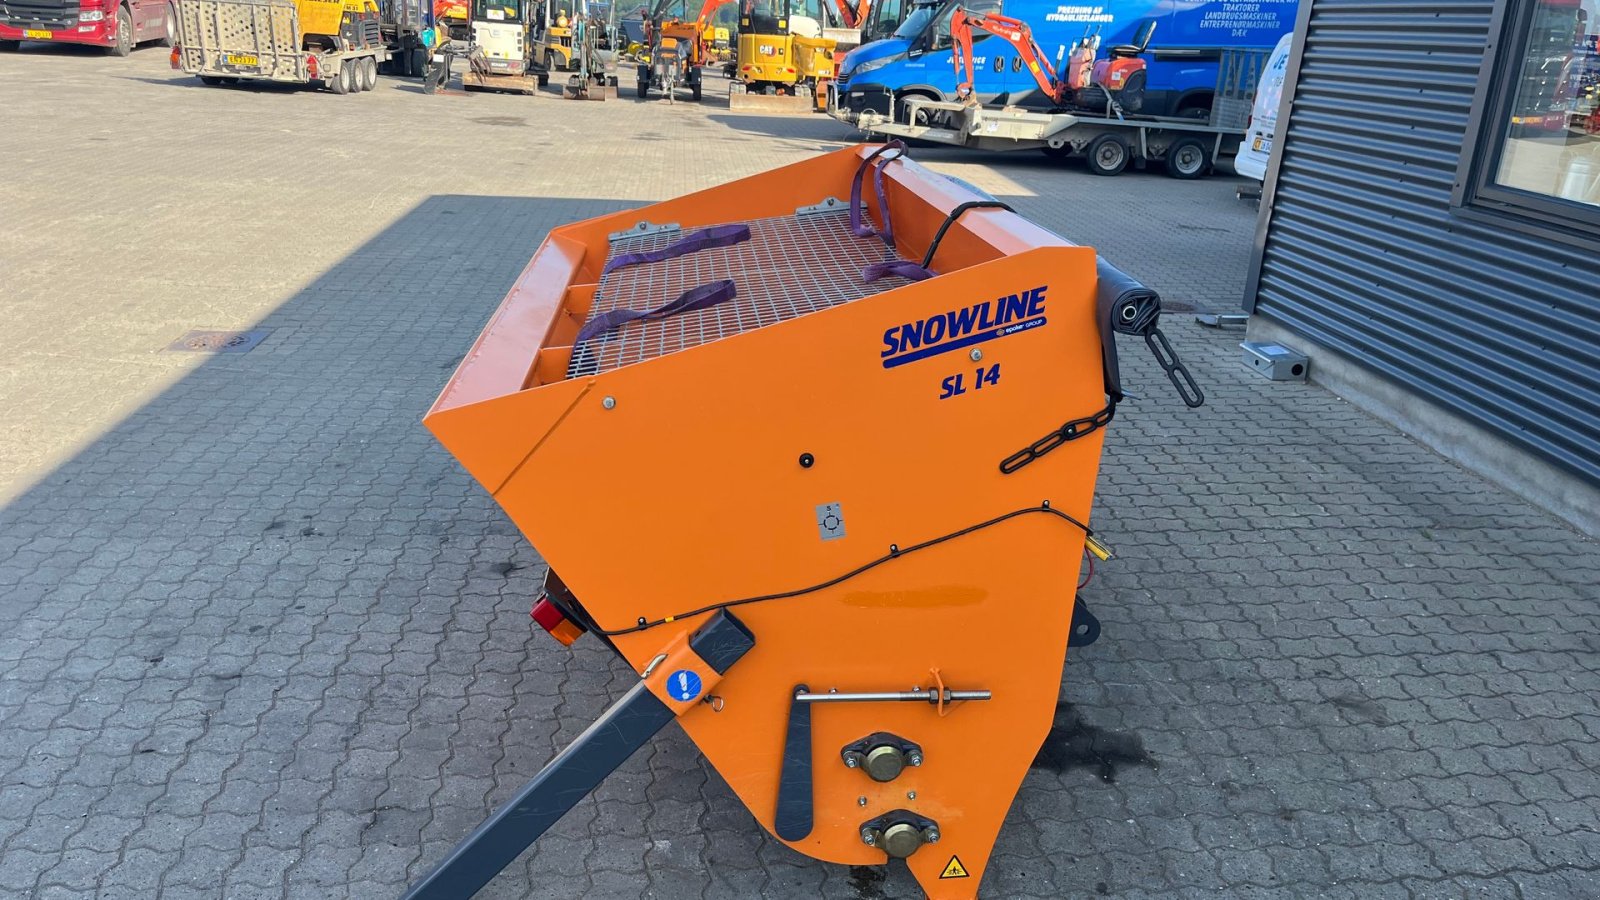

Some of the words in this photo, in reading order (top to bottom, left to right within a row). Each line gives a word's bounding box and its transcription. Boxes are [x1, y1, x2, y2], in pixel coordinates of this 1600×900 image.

[1222, 3, 1260, 12] TRAKTORER
[1204, 11, 1277, 20] LANDBRUGSMASKINER
[1199, 20, 1281, 29] ENTREPRENØRMASKINER
[1231, 28, 1248, 37] DÆK
[760, 45, 773, 55] CAT
[881, 286, 1048, 358] SNOWLINE
[1025, 319, 1043, 327] GROUP
[939, 373, 967, 400] SL
[975, 363, 1001, 390] 14
